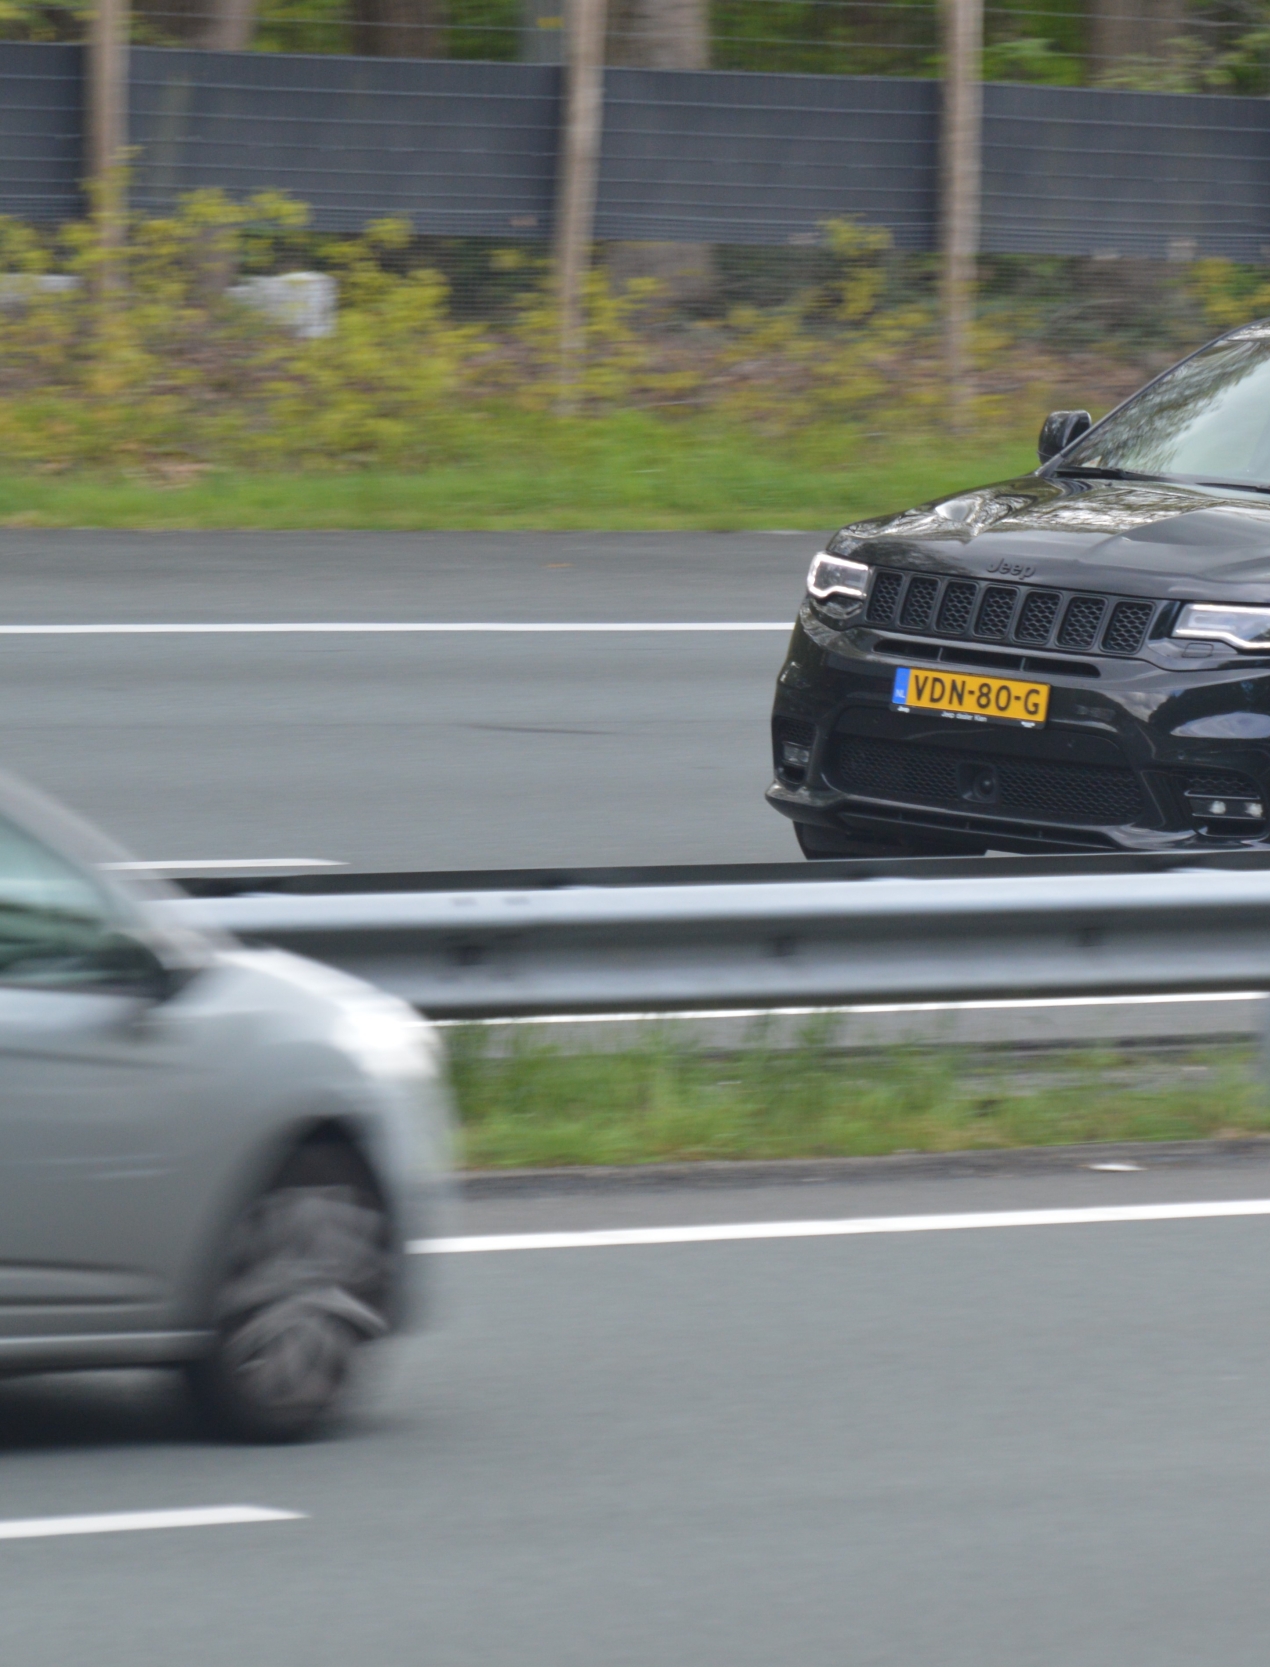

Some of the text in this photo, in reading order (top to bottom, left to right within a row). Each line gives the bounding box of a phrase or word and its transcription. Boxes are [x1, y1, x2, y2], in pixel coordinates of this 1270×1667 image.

[986, 557, 1037, 581] Jeep
[895, 688, 906, 699] NL
[914, 674, 1041, 716] VDN-80-G
